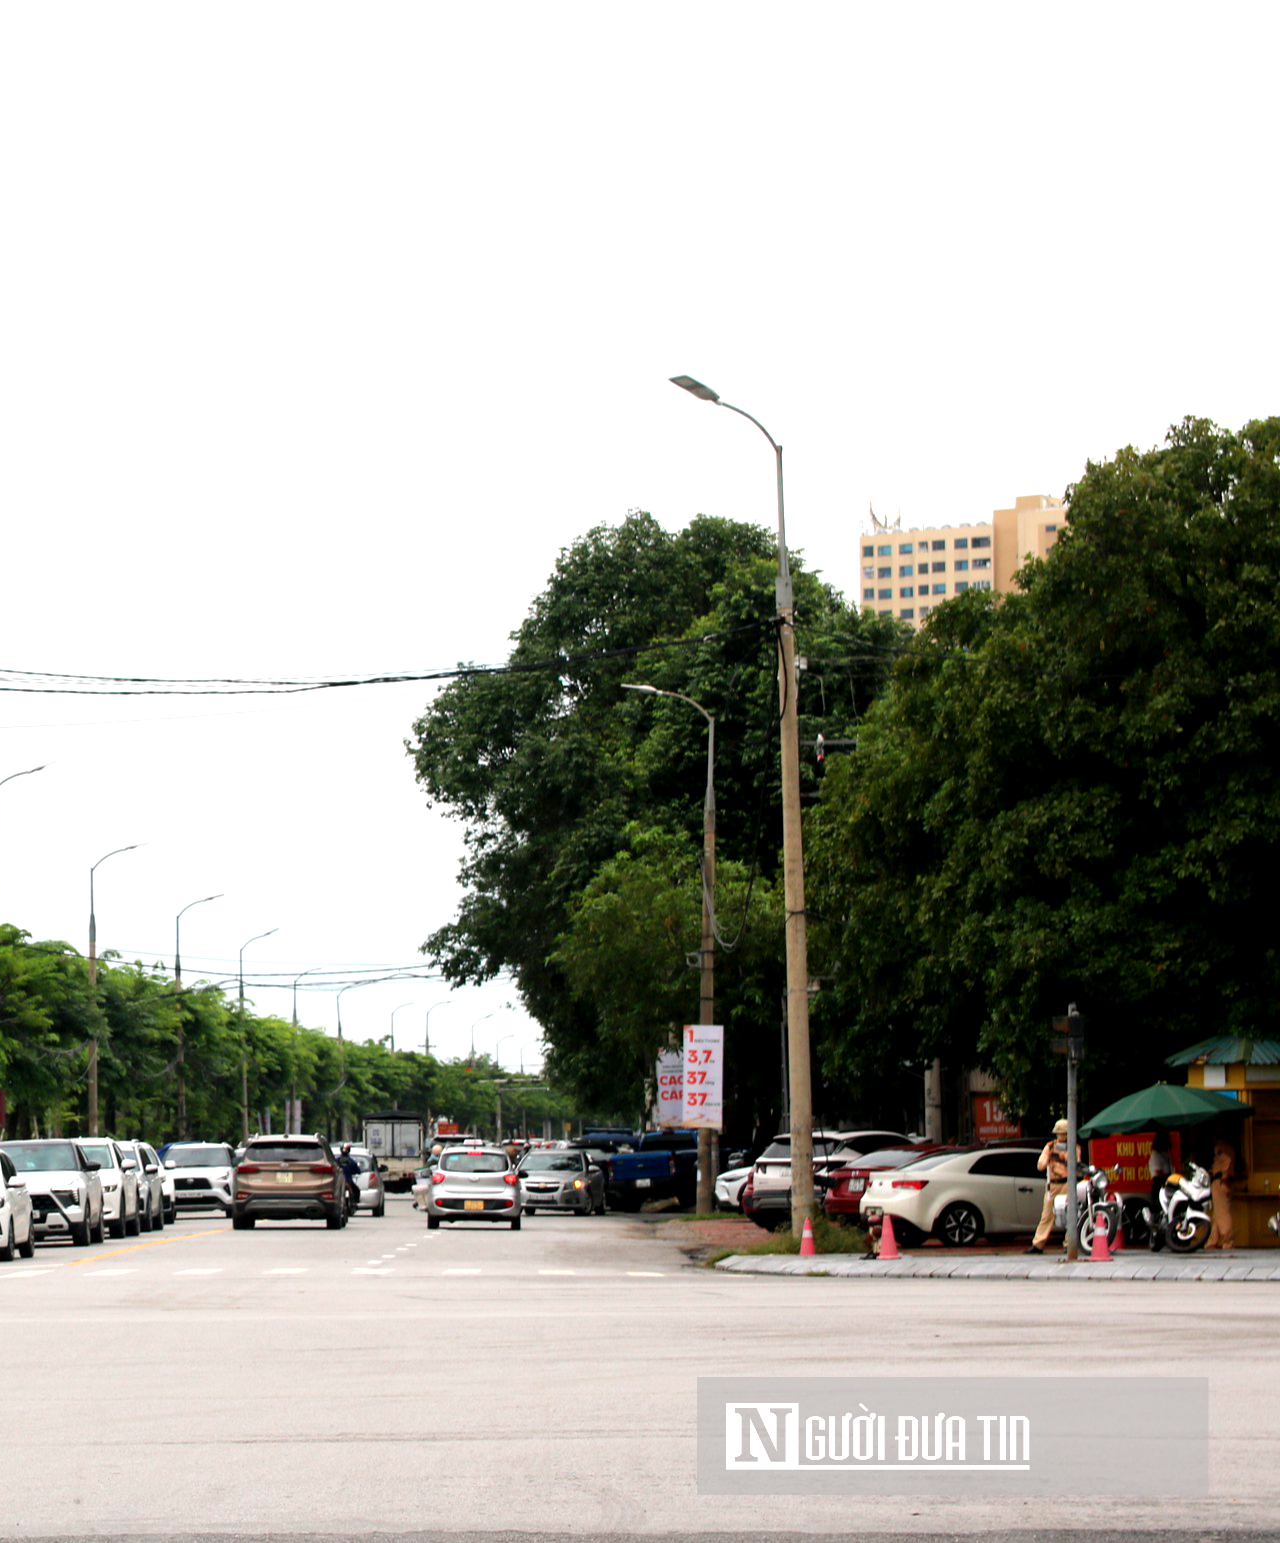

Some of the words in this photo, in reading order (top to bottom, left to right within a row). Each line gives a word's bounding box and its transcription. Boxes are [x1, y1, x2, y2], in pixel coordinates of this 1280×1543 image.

[687, 1029, 694, 1043] 1
[687, 1049, 712, 1066] 3,7
[687, 1071, 707, 1085] 37
[687, 1092, 708, 1106] 37
[1116, 1141, 1135, 1157] KHU
